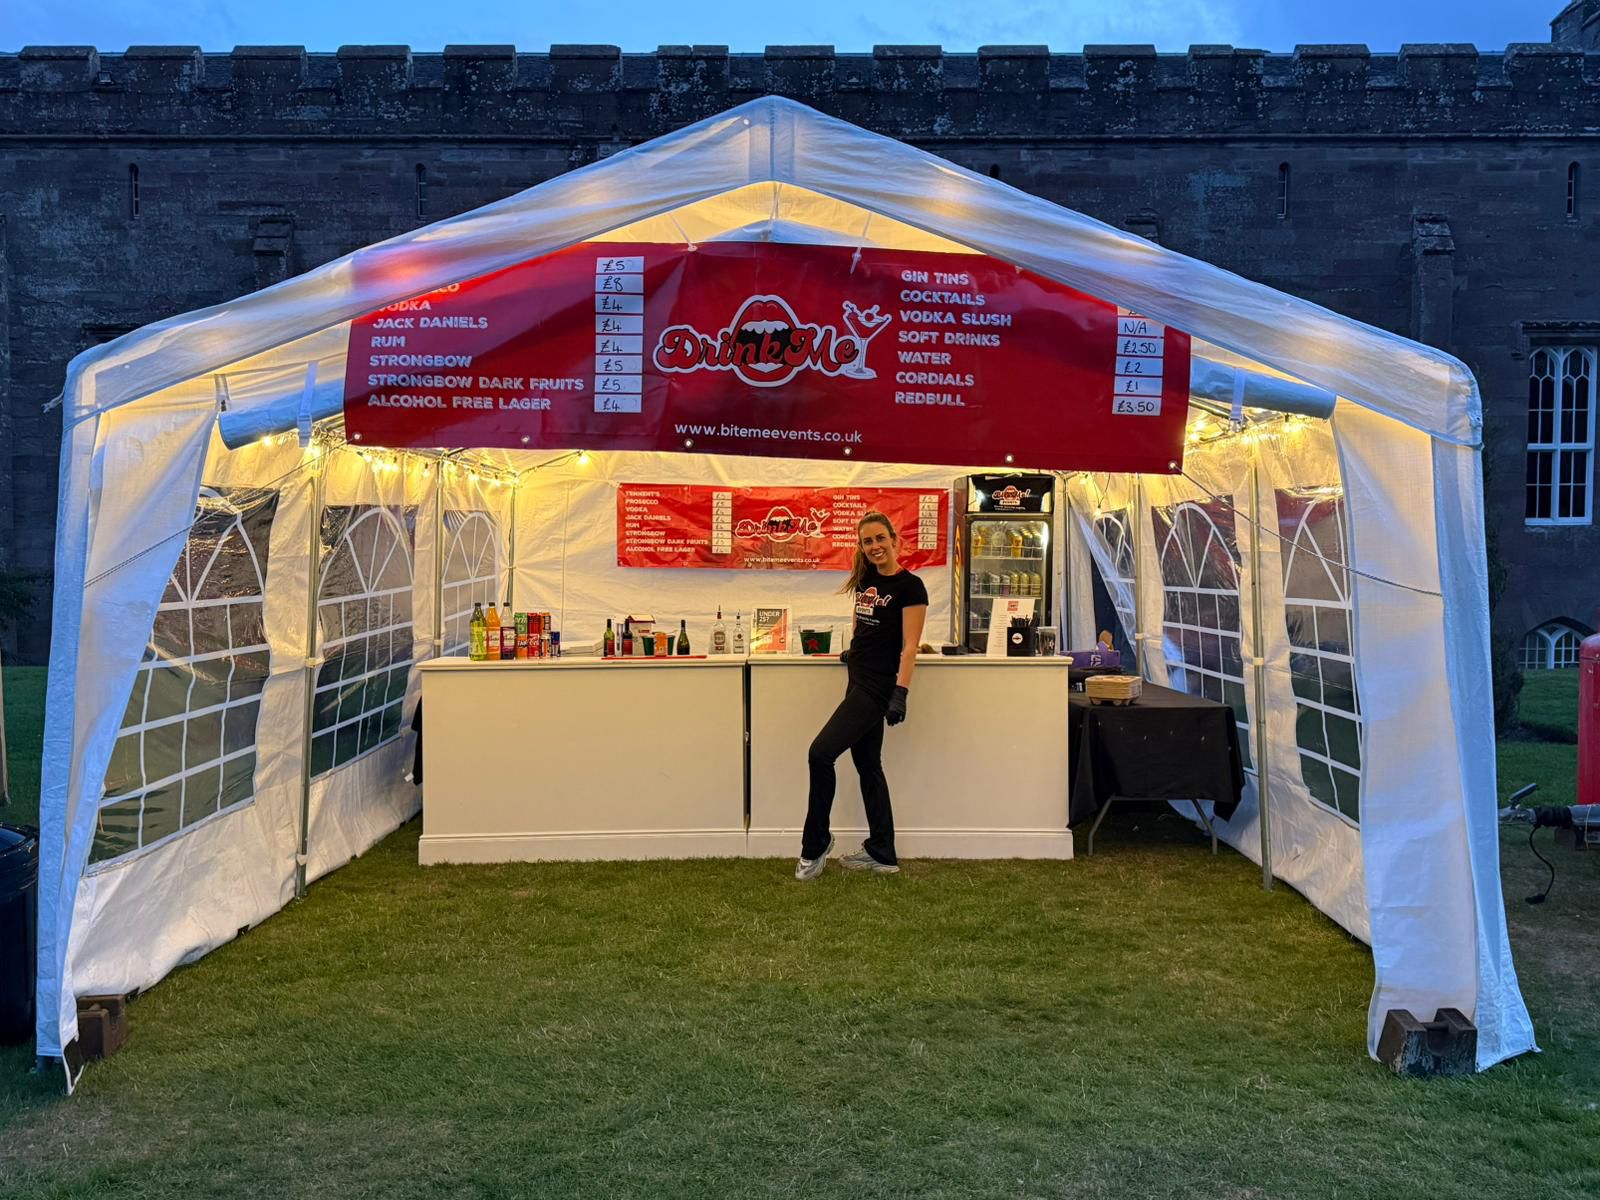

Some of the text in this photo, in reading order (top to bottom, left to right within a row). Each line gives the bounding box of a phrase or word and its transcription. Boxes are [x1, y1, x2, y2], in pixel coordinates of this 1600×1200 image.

[603, 259, 625, 272] £5
[602, 276, 623, 292] £8
[901, 270, 969, 285] GIN TINS
[602, 296, 623, 312] £4
[900, 289, 985, 306] COCKTAILS
[373, 316, 488, 329] JACK DANIELS
[602, 319, 622, 332] £4
[900, 310, 1012, 327] VODKA SLUSH
[1124, 321, 1147, 334] N/A
[371, 336, 406, 348] RUM
[601, 339, 623, 352] £4
[898, 330, 1001, 347] SOFT DRINKS
[656, 326, 861, 374] Drink Me
[369, 355, 472, 368] STRONGBOW
[898, 351, 952, 365] WATER
[604, 359, 624, 372] £5
[1124, 362, 1143, 374] £2
[368, 374, 585, 391] STRONGBOW DARK FRUITS
[602, 379, 621, 391] £5
[896, 372, 975, 387] CORDIALS
[1125, 380, 1139, 393] £1
[368, 393, 552, 410] ALCOHOL FREE LAGER
[602, 398, 620, 411] £4
[895, 391, 965, 407] REDBULL
[675, 424, 863, 443] www.bitemeevents.co.uk
